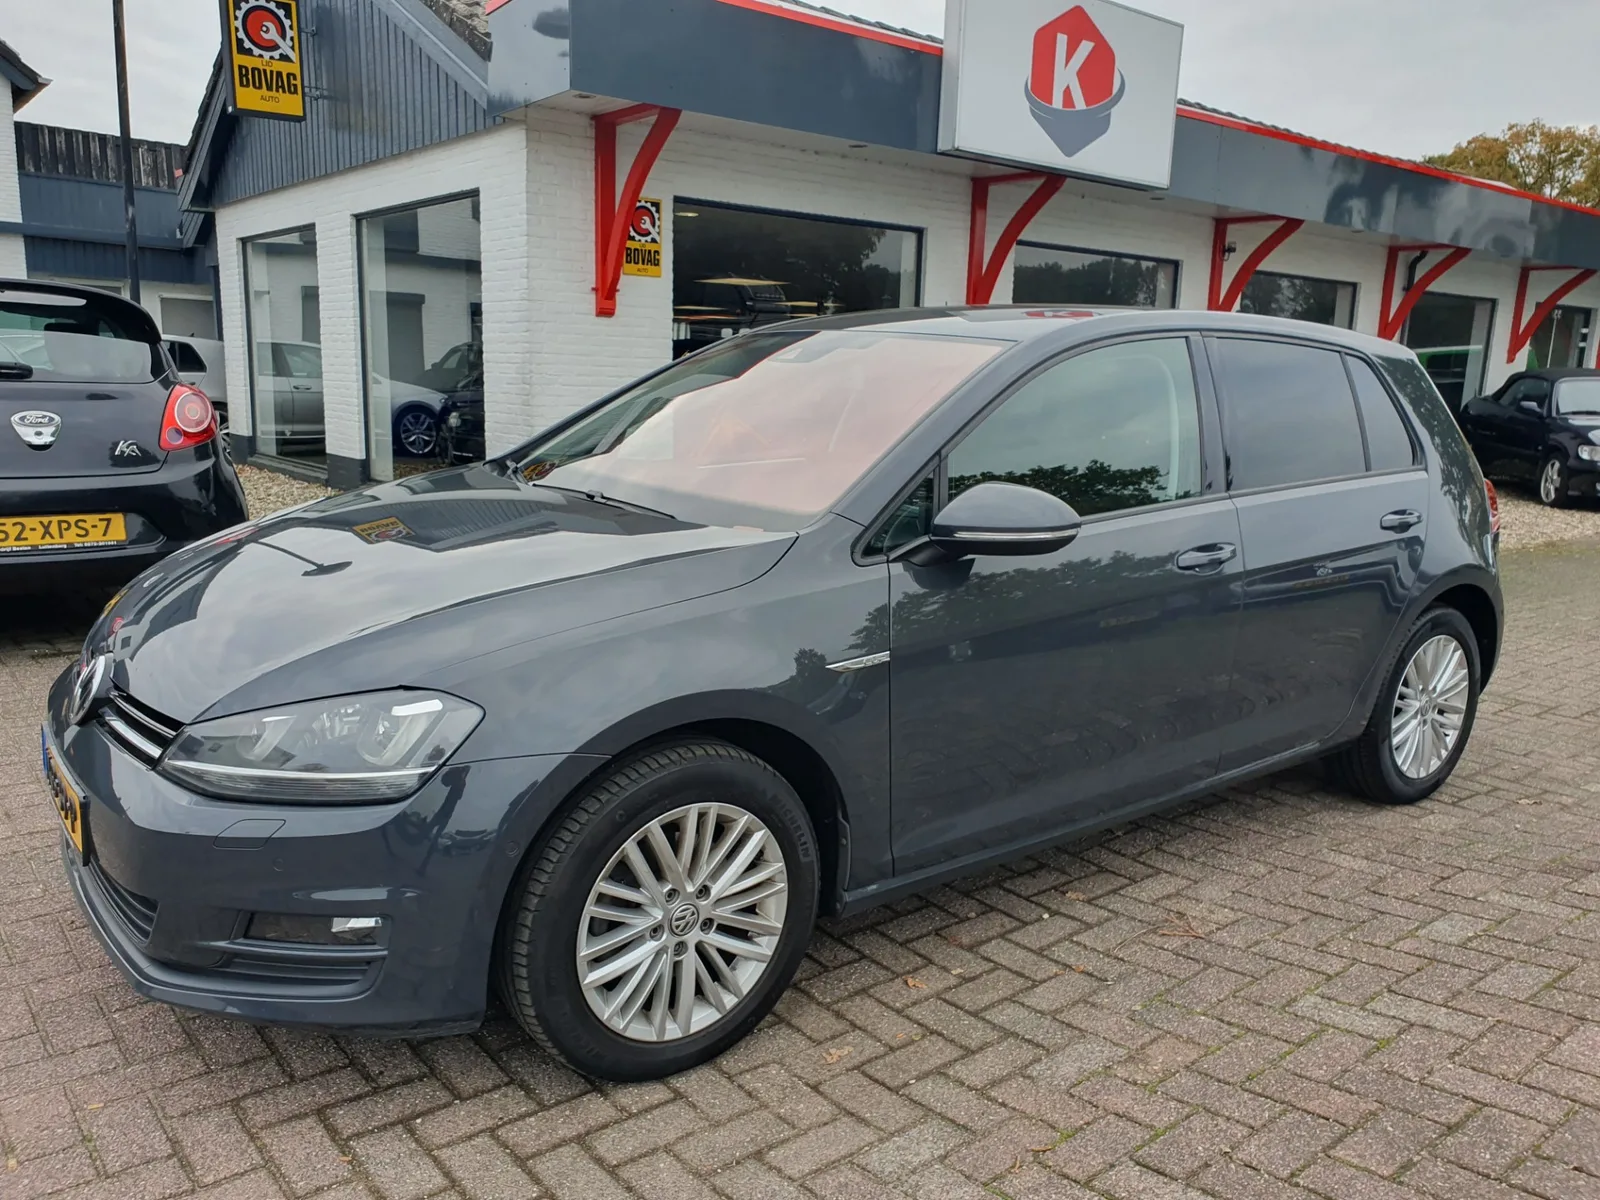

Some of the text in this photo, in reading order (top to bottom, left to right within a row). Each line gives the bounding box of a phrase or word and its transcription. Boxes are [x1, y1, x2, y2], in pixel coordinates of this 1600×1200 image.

[260, 60, 273, 68] LID
[1052, 32, 1095, 109] K
[238, 64, 298, 96] BOVAG
[260, 95, 280, 104] AUTO
[625, 247, 660, 267] BOVAG
[24, 414, 49, 424] Ford
[0, 518, 112, 543] 52-XPS-7
